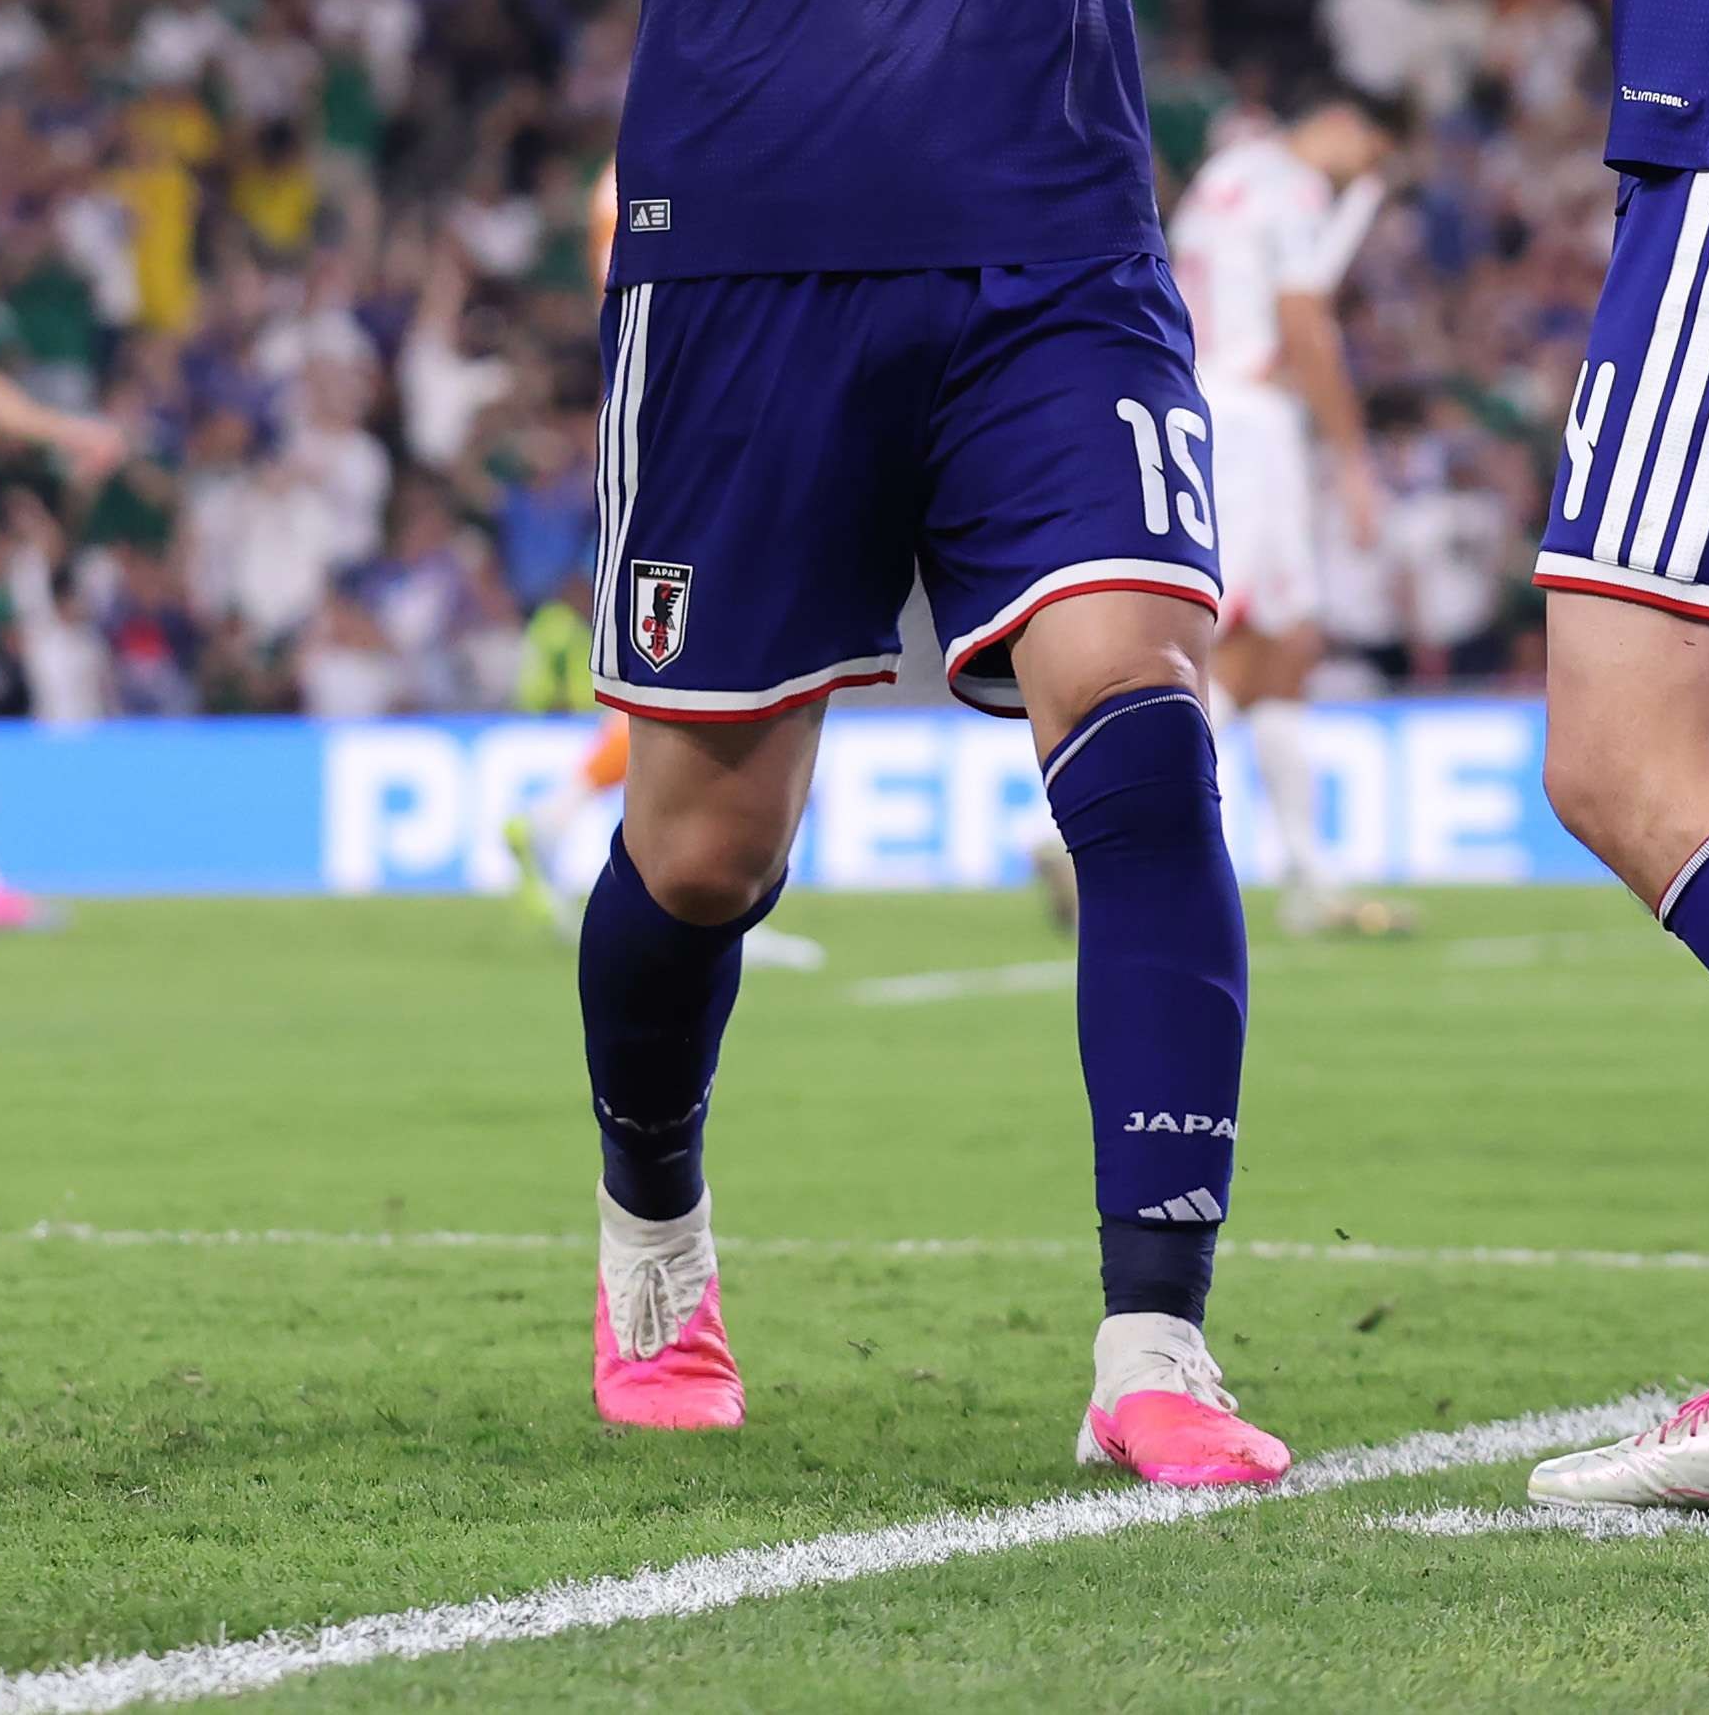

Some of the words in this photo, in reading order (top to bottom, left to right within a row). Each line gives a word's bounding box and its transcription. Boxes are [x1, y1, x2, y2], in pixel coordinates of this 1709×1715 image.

[1115, 397, 1215, 551] 15
[648, 567, 681, 579] JAPAN
[1123, 1110, 1239, 1142] JAPA
